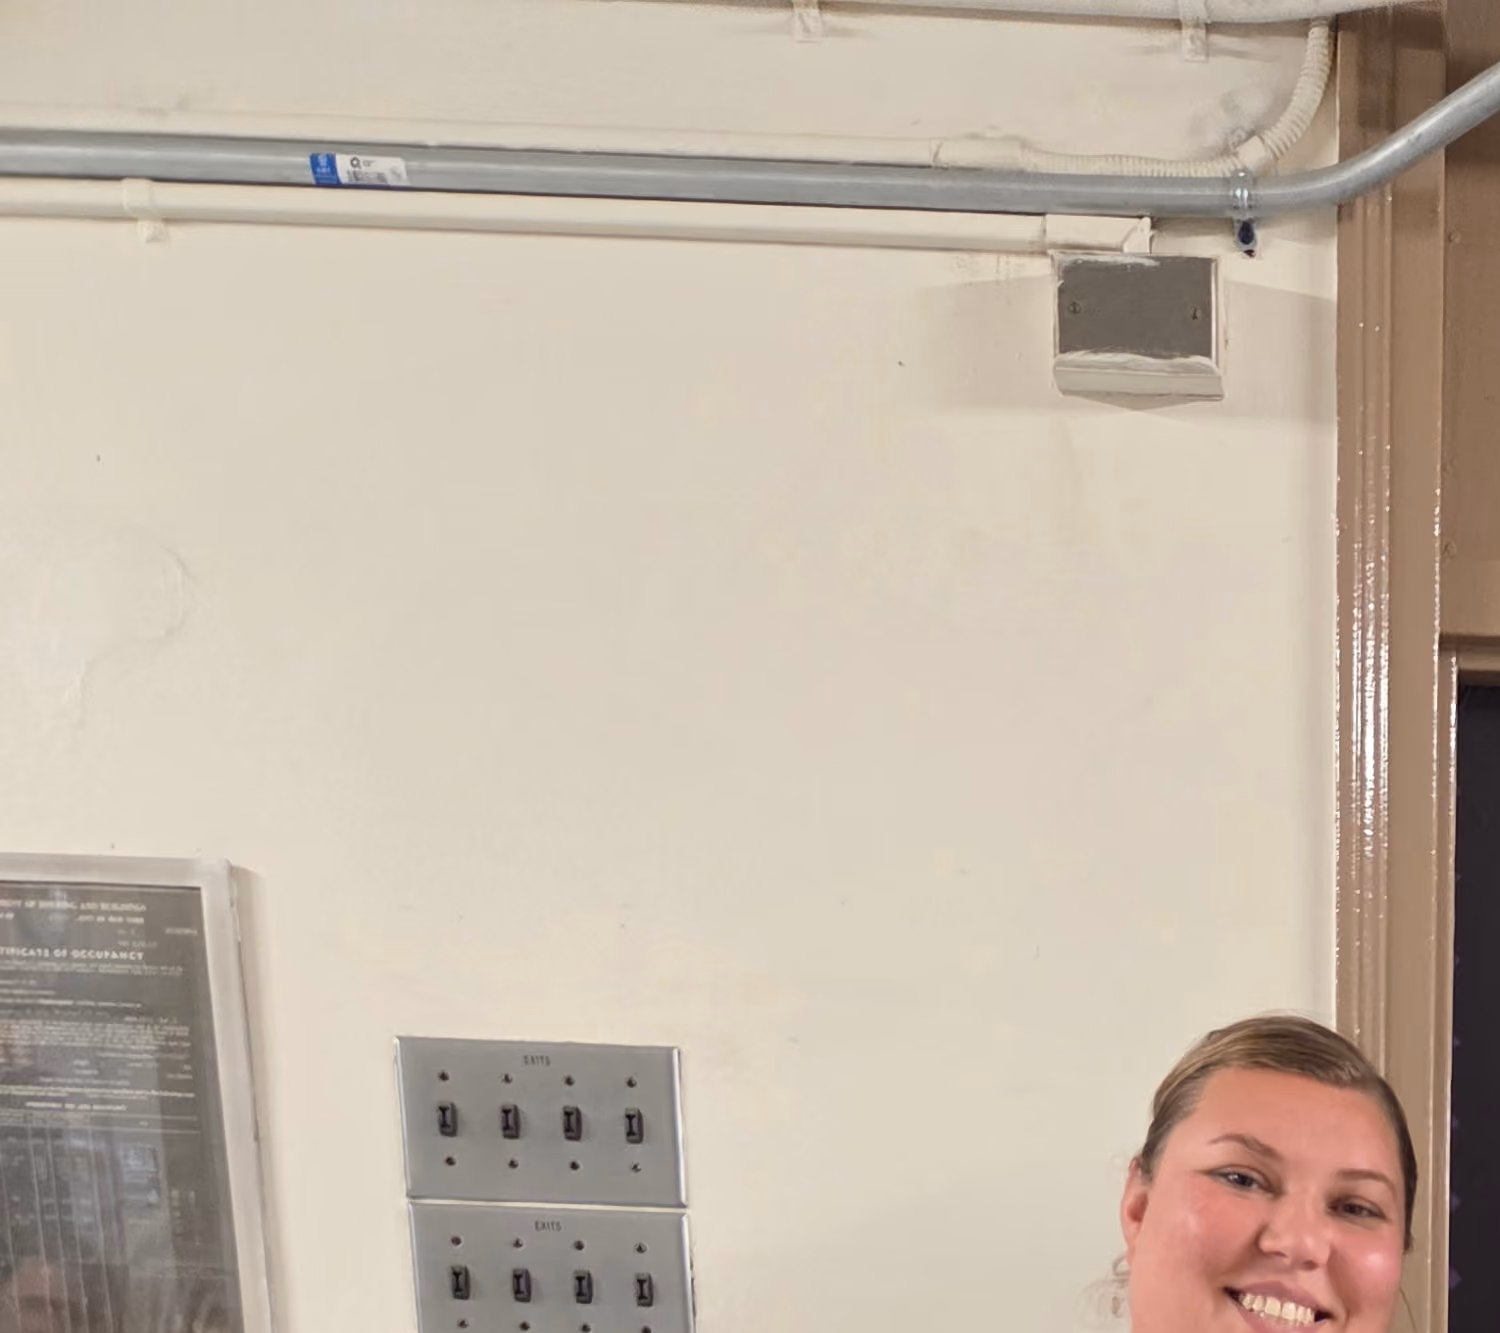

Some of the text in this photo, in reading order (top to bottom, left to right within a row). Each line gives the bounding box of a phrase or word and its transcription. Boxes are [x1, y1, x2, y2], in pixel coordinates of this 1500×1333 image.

[0, 945, 50, 958] TIFICATE
[72, 949, 145, 961] OCCUPANCY
[523, 1055, 551, 1067] EXITS
[534, 1220, 562, 1232] EXITS
